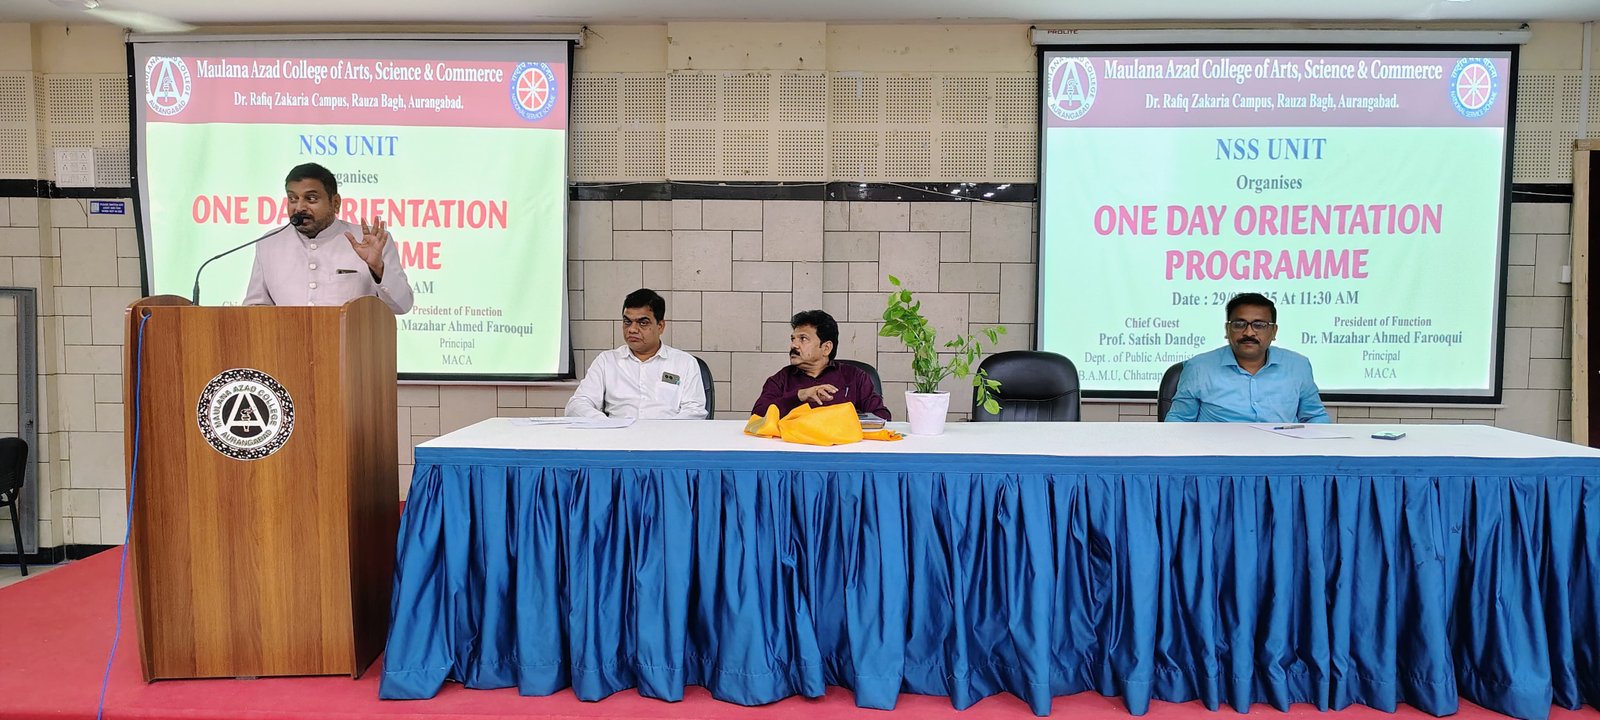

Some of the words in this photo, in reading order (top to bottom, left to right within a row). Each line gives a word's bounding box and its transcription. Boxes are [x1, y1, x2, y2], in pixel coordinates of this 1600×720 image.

[196, 59, 249, 78] Maulana
[251, 59, 280, 79] Azad
[282, 60, 328, 84] College
[330, 60, 343, 79] of
[344, 62, 372, 83] Arts,
[375, 62, 421, 80] Science
[424, 63, 434, 81] &
[436, 62, 503, 82] Commerce
[1104, 59, 1164, 79] Maulana
[1166, 58, 1200, 79] Azad
[1202, 58, 1252, 84] College
[1255, 58, 1270, 78] of
[1270, 60, 1301, 82] Arts,
[1304, 59, 1354, 79] Science
[1358, 60, 1368, 79] &
[1370, 60, 1442, 80] Commerce
[234, 92, 248, 106] Dr.
[250, 92, 272, 109] Rafiq
[275, 92, 309, 106] Zakaria
[312, 93, 349, 110] Campus,
[352, 93, 378, 107] Rauza
[381, 94, 406, 111] Bagh,
[408, 95, 464, 112] Aurangabad.
[1146, 94, 1160, 108] Dr.
[1164, 94, 1189, 112] Rafiq
[1191, 94, 1230, 108] Zakaria
[1232, 93, 1274, 112] Campus,
[1277, 93, 1307, 108] Rauza
[1310, 93, 1336, 112] Bagh,
[1338, 94, 1400, 112] Aurangabad.
[299, 134, 338, 156] NSS
[345, 135, 399, 156] UNIT
[1216, 138, 1259, 160] NSS
[1268, 138, 1327, 160] UNIT
[335, 170, 379, 187] ganises
[1236, 174, 1302, 193] Organises
[192, 195, 250, 224] ONE
[257, 196, 290, 224] DA
[338, 198, 508, 229] RIENTATION
[1094, 204, 1158, 236] ONE
[1166, 204, 1228, 236] DAY
[1234, 204, 1443, 236] ORIENTATION
[1165, 248, 1370, 280] PROGRAMME
[413, 281, 434, 294] AM
[1172, 292, 1200, 306] Date
[1280, 292, 1296, 305] At
[1300, 291, 1332, 305] 11:30
[1334, 290, 1360, 305] AM
[412, 305, 451, 316] President
[454, 306, 464, 316] of
[464, 306, 502, 317] Function
[401, 319, 446, 332] Mazahar
[448, 320, 484, 333] Ahmed
[486, 321, 533, 337] Farooqui
[1124, 317, 1151, 328] Chief
[1152, 317, 1180, 328] Guest
[1334, 316, 1377, 327] President
[1380, 316, 1391, 327] of
[1392, 316, 1432, 327] Function
[440, 338, 475, 351] Principal
[1100, 333, 1126, 346] Prof.
[1128, 332, 1161, 346] Satish
[1164, 332, 1206, 347] Dandge
[1301, 332, 1318, 344] Dr.
[1322, 332, 1370, 344] Mazahar
[1372, 332, 1410, 344] Ahmed
[1414, 331, 1462, 346] Farooqui
[442, 354, 472, 366] MACA
[1084, 352, 1106, 366] Dept
[1113, 352, 1124, 363] of
[1126, 352, 1152, 363] Public
[1362, 350, 1400, 363] Principal
[1364, 368, 1397, 379] MACA
[213, 390, 232, 428] MAULANA
[232, 385, 257, 393] AZAD
[258, 390, 278, 426] COLLEGE
[220, 430, 272, 446] AURANGABAD
